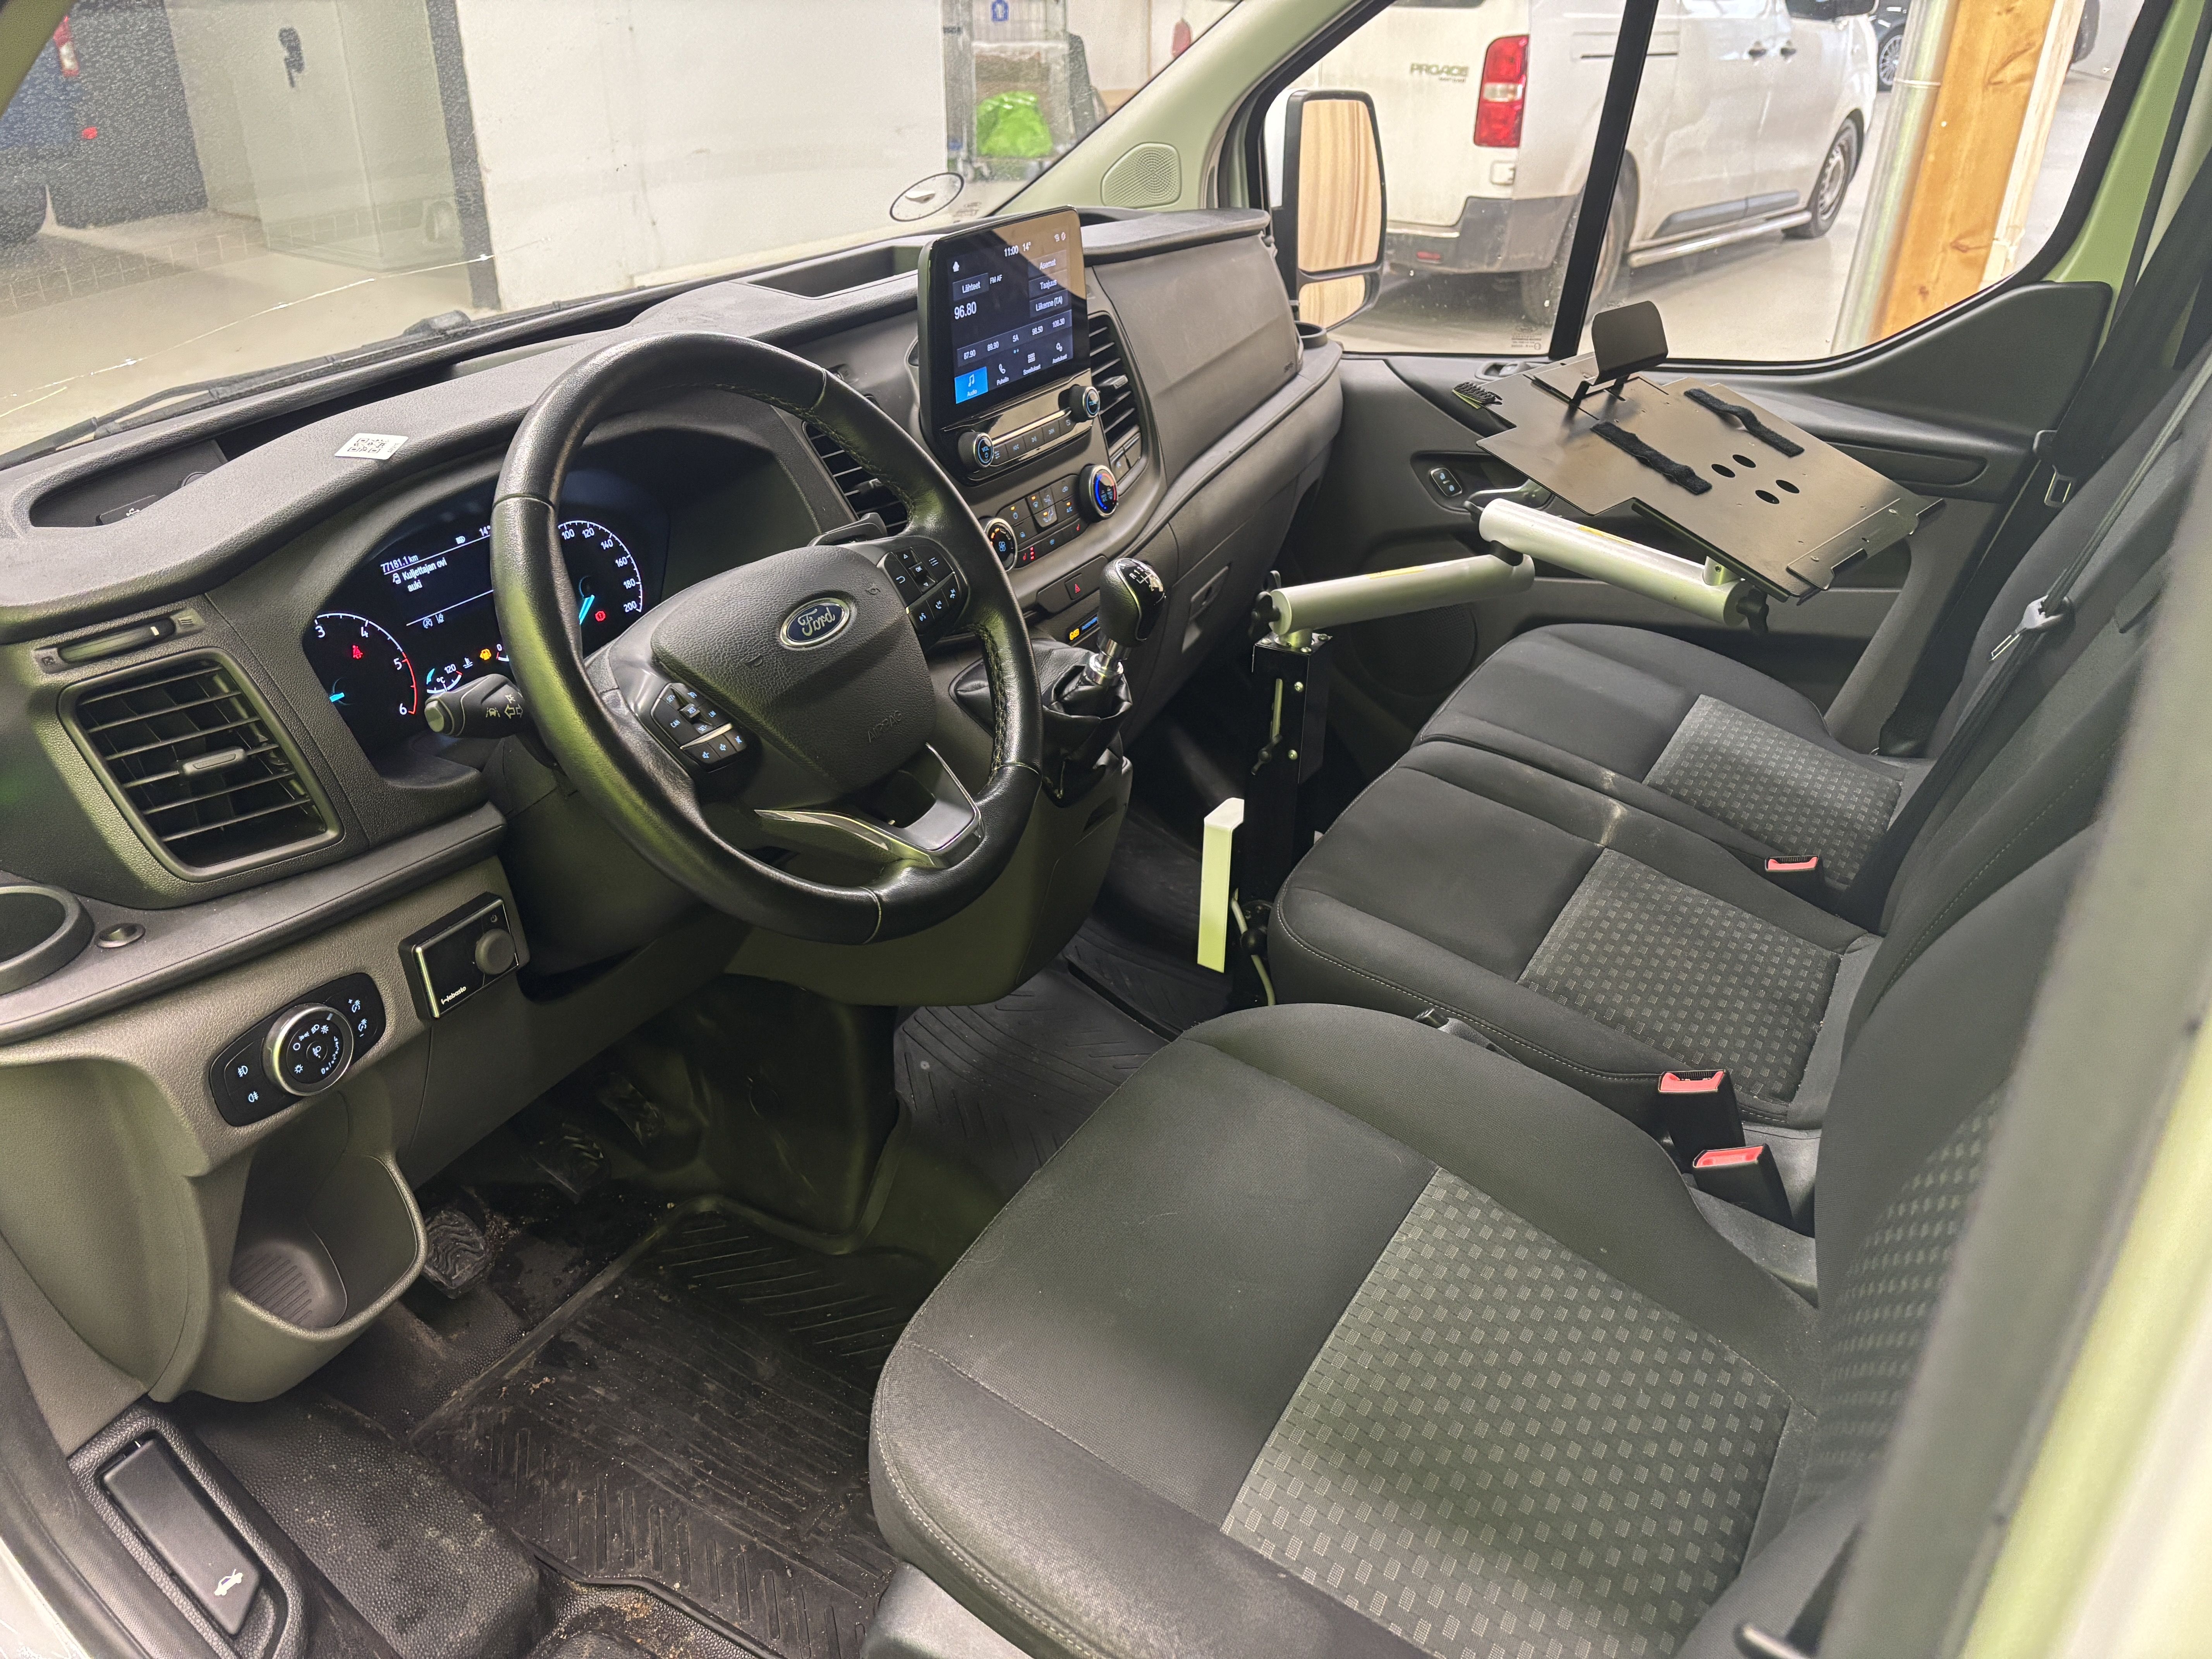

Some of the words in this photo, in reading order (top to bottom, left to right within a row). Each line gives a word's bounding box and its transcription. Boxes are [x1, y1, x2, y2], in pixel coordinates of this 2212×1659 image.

[1004, 245, 1019, 257] 11:00
[1022, 242, 1031, 251] 14°
[1039, 258, 1056, 270] Asemat
[962, 281, 981, 293] Lähteet
[1040, 279, 1057, 290] Taajuus
[1036, 301, 1053, 311] Liikenne
[1054, 296, 1063, 306] (TA)
[954, 301, 977, 319] 96.80
[963, 349, 976, 360] 87.90
[562, 529, 575, 540] 100
[582, 527, 595, 538] 120
[601, 539, 613, 550] 140
[380, 556, 408, 573] 77181.1
[409, 554, 419, 563] km
[615, 556, 628, 567] 160
[402, 563, 437, 580] Kuljettajan
[437, 557, 447, 568] ovi
[407, 580, 423, 592] auki
[623, 578, 635, 589] 180
[623, 601, 637, 613] 200
[797, 607, 836, 637] Ford
[315, 625, 326, 638] 3
[361, 627, 369, 638] 4
[393, 658, 402, 670] 5
[444, 664, 456, 674] 120
[399, 703, 407, 715] 6
[687, 706, 696, 714] RES
[670, 719, 681, 728] CAN
[867, 710, 902, 743] AIRBAG
